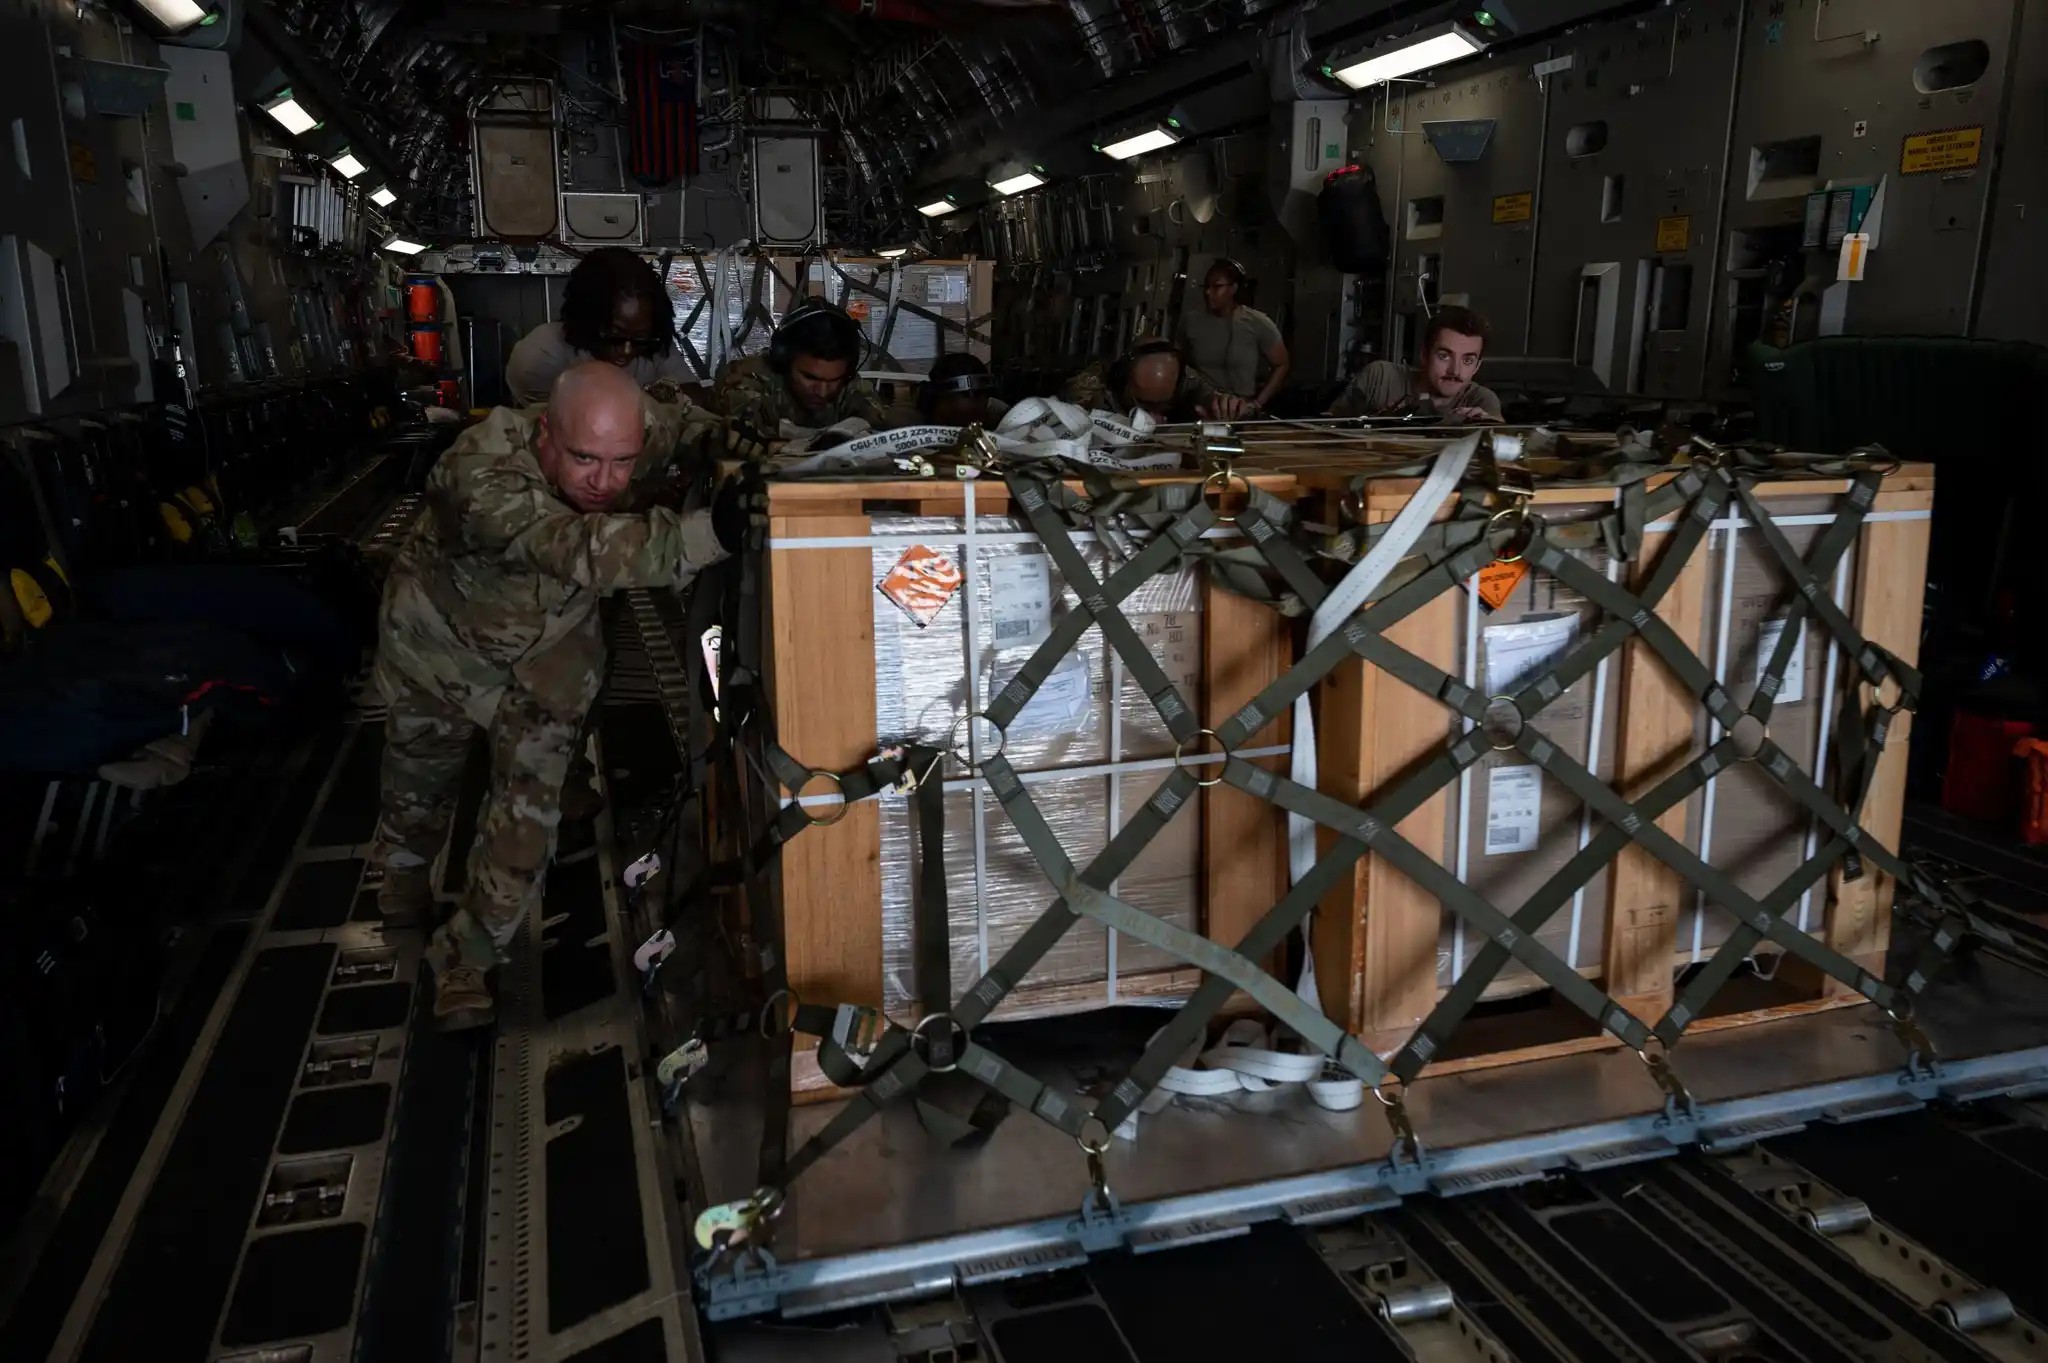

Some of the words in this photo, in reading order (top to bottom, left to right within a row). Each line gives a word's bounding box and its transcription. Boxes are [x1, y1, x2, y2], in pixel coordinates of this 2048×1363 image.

[850, 436, 887, 452] CGU-1/B
[889, 430, 909, 442] CL2
[895, 438, 918, 451] 5000
